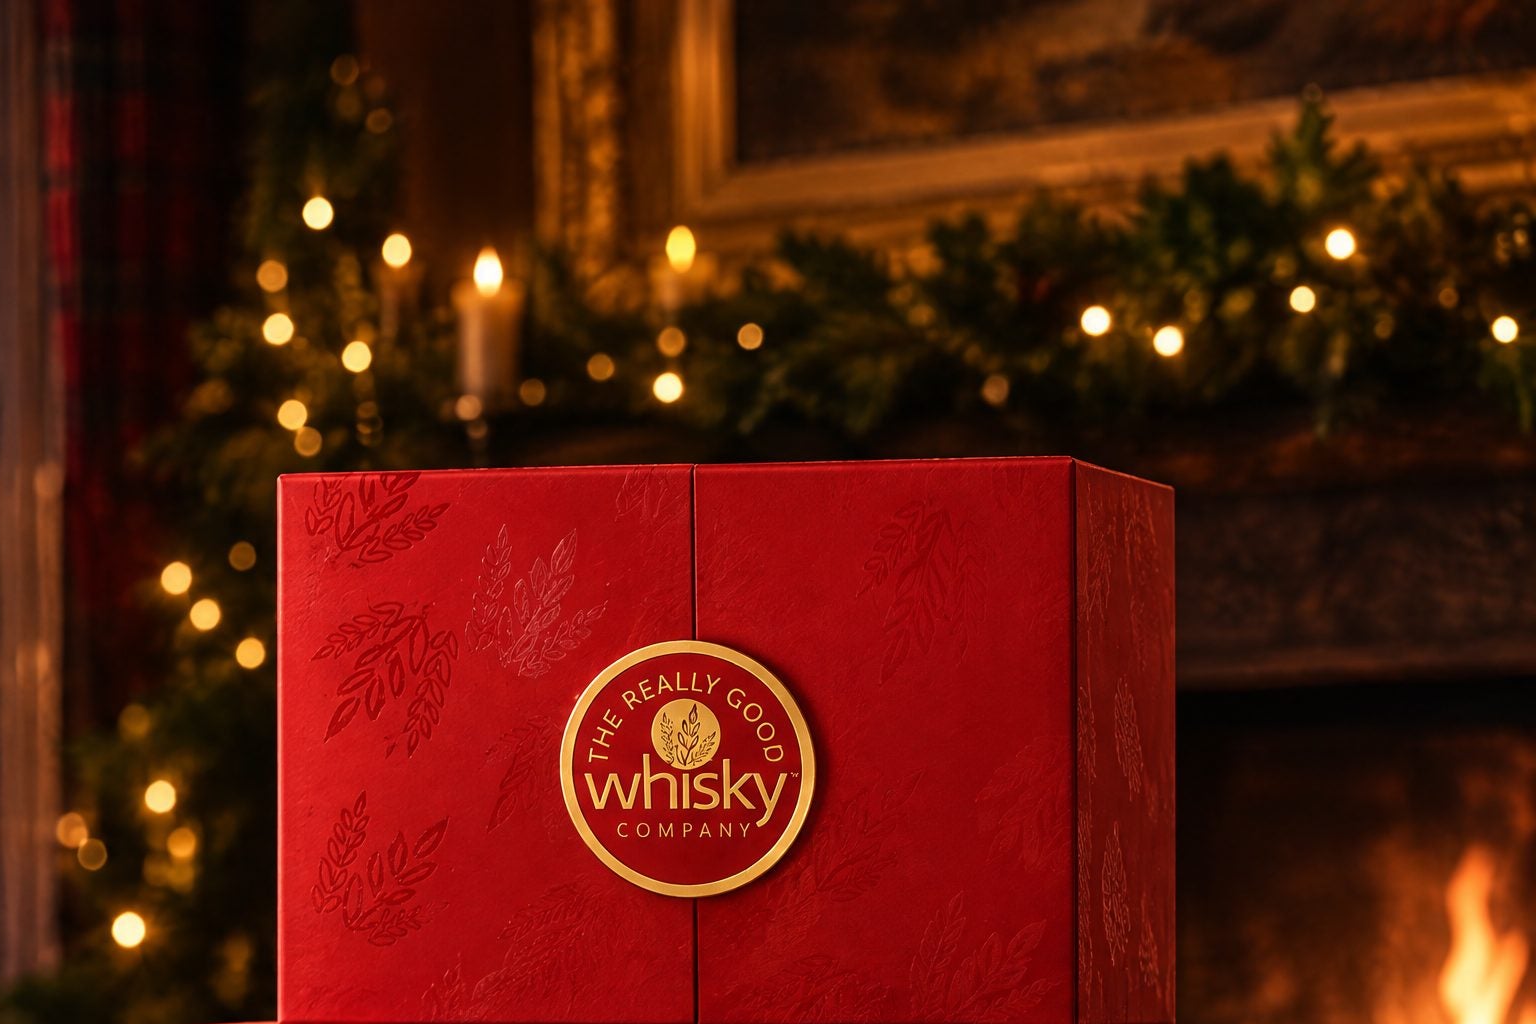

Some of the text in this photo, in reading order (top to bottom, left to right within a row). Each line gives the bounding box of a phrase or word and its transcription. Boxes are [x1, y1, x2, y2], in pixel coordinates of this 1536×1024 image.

[588, 671, 784, 763] THE REALLY GOOD
[584, 753, 788, 828] whisky
[616, 822, 751, 838] COMPANY
